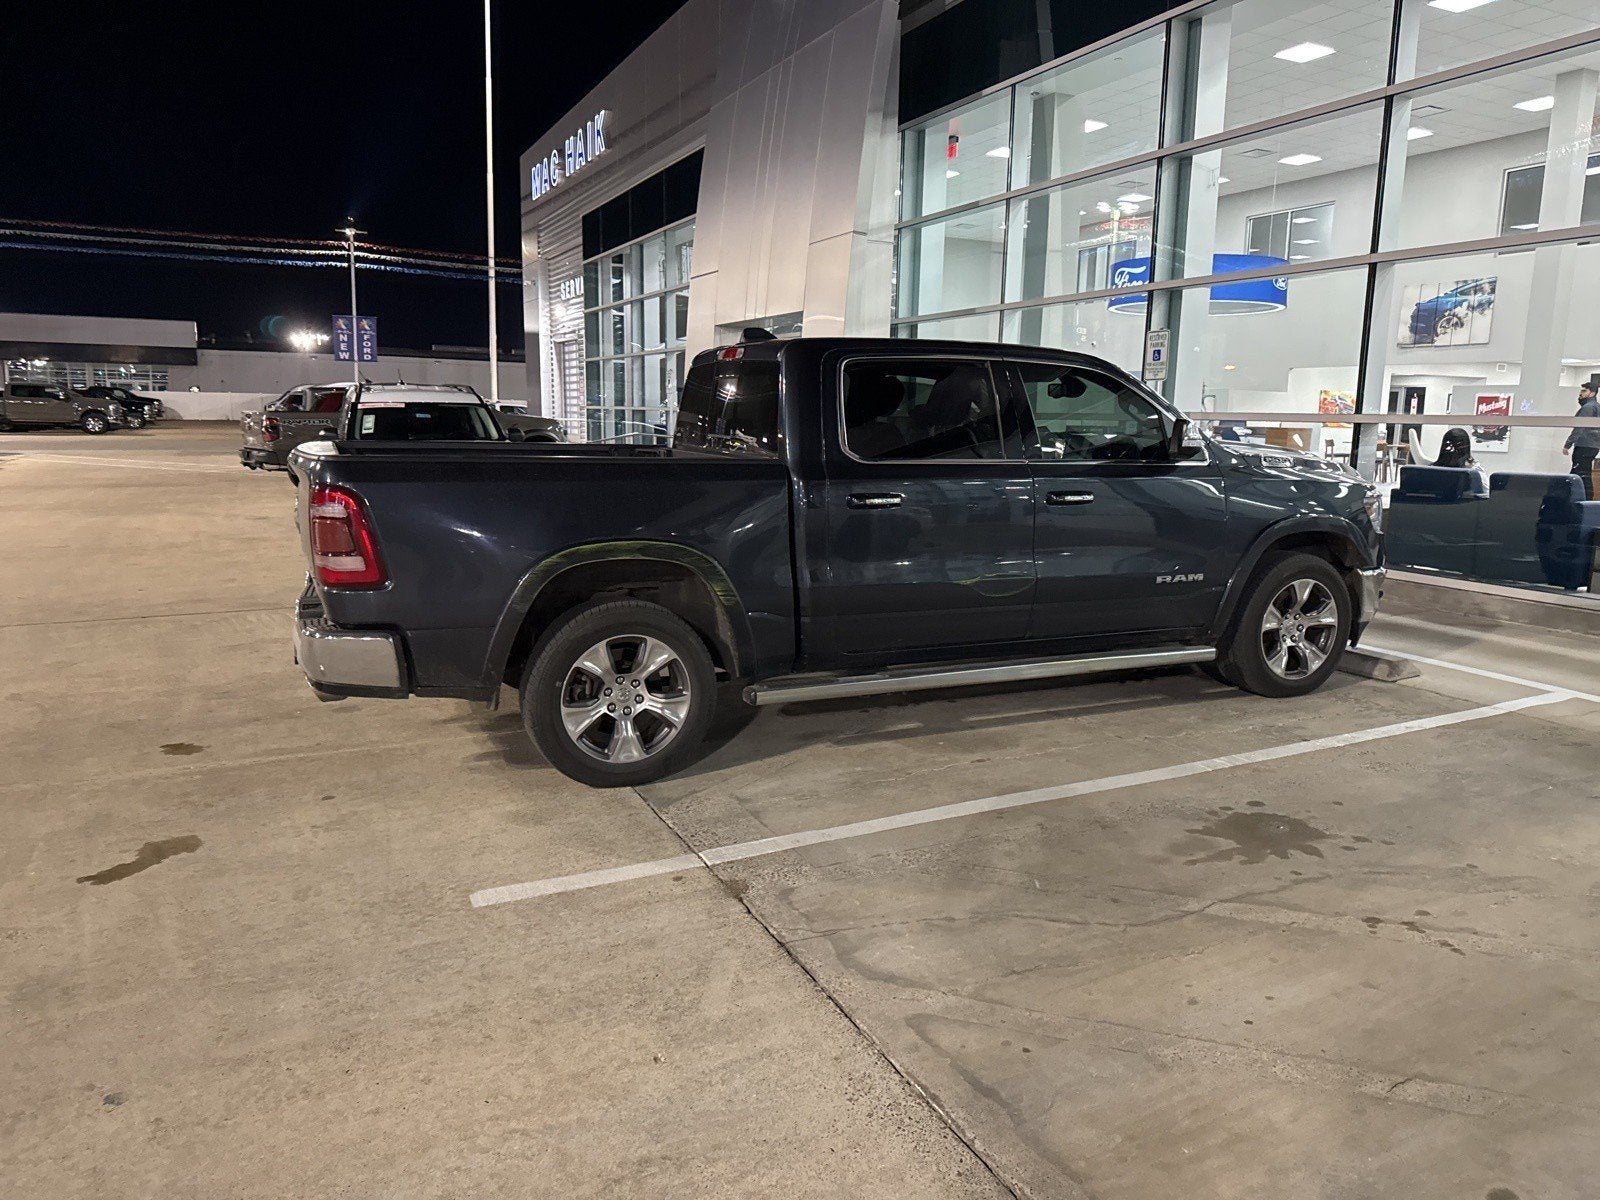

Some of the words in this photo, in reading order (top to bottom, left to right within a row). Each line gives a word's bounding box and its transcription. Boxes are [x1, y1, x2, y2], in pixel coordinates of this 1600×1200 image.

[565, 109, 606, 177] HAIK
[338, 333, 350, 360] NEW
[362, 334, 372, 361] FORD
[1478, 400, 1508, 415] Mustang
[282, 418, 332, 428] RAPTOR
[1156, 573, 1204, 584] RAM
